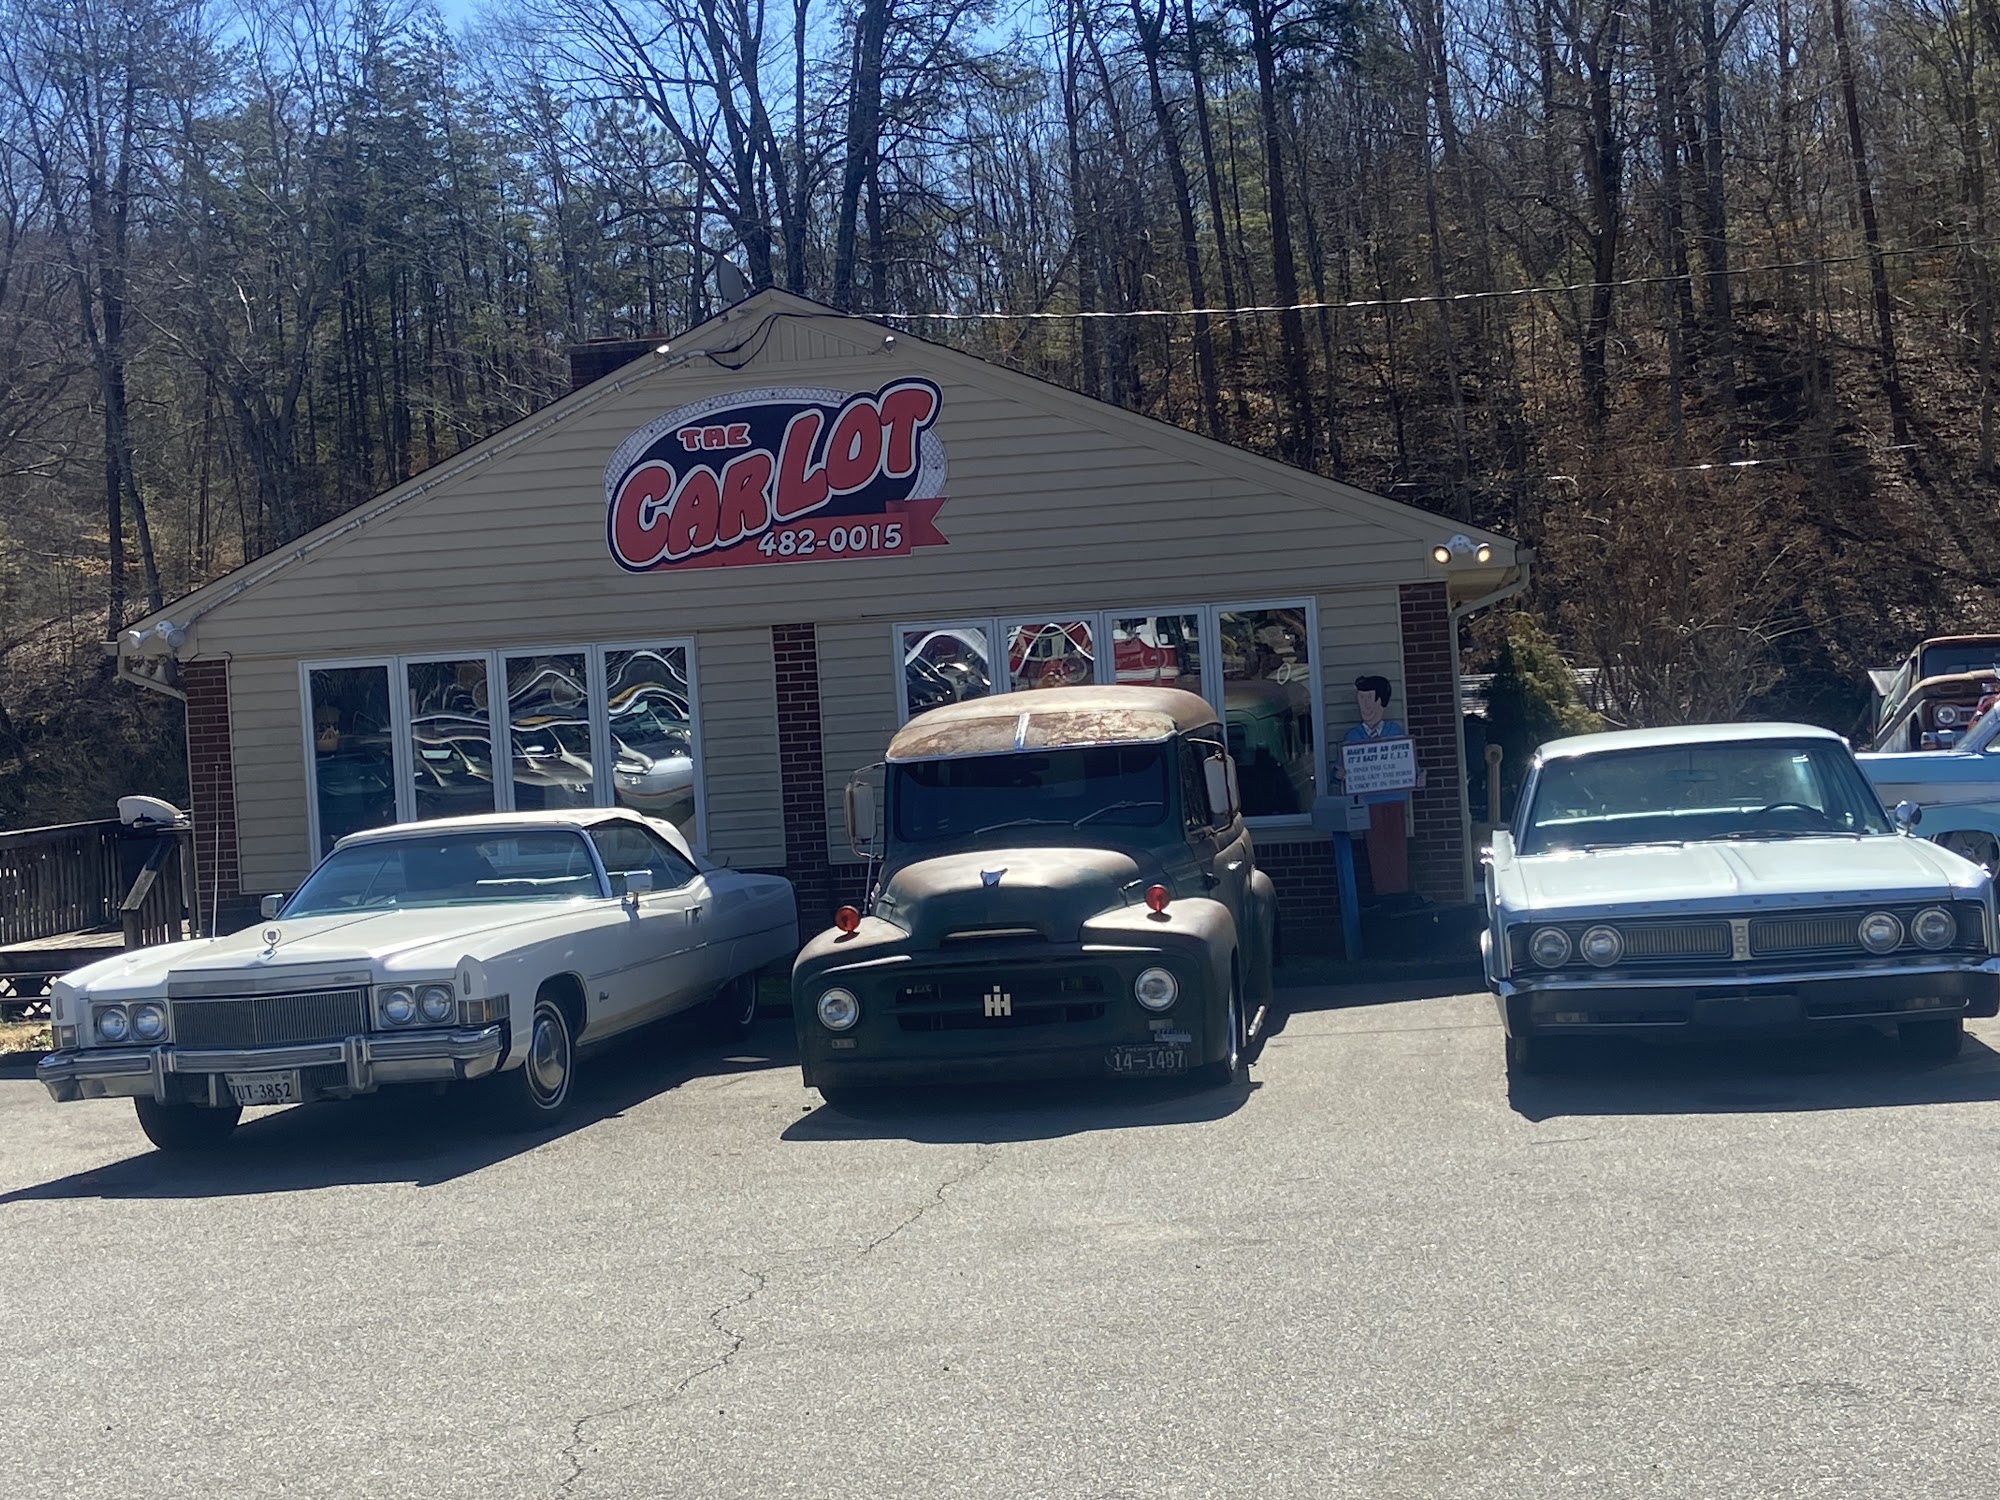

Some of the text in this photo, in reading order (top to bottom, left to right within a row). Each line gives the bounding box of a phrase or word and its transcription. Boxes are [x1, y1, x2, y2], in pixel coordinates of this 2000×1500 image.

[678, 424, 751, 452] THE
[610, 381, 936, 567] CAR LOT
[758, 523, 903, 557] 482-0015
[1363, 754, 1377, 762] EASY
[1391, 743, 1409, 751] OFFER
